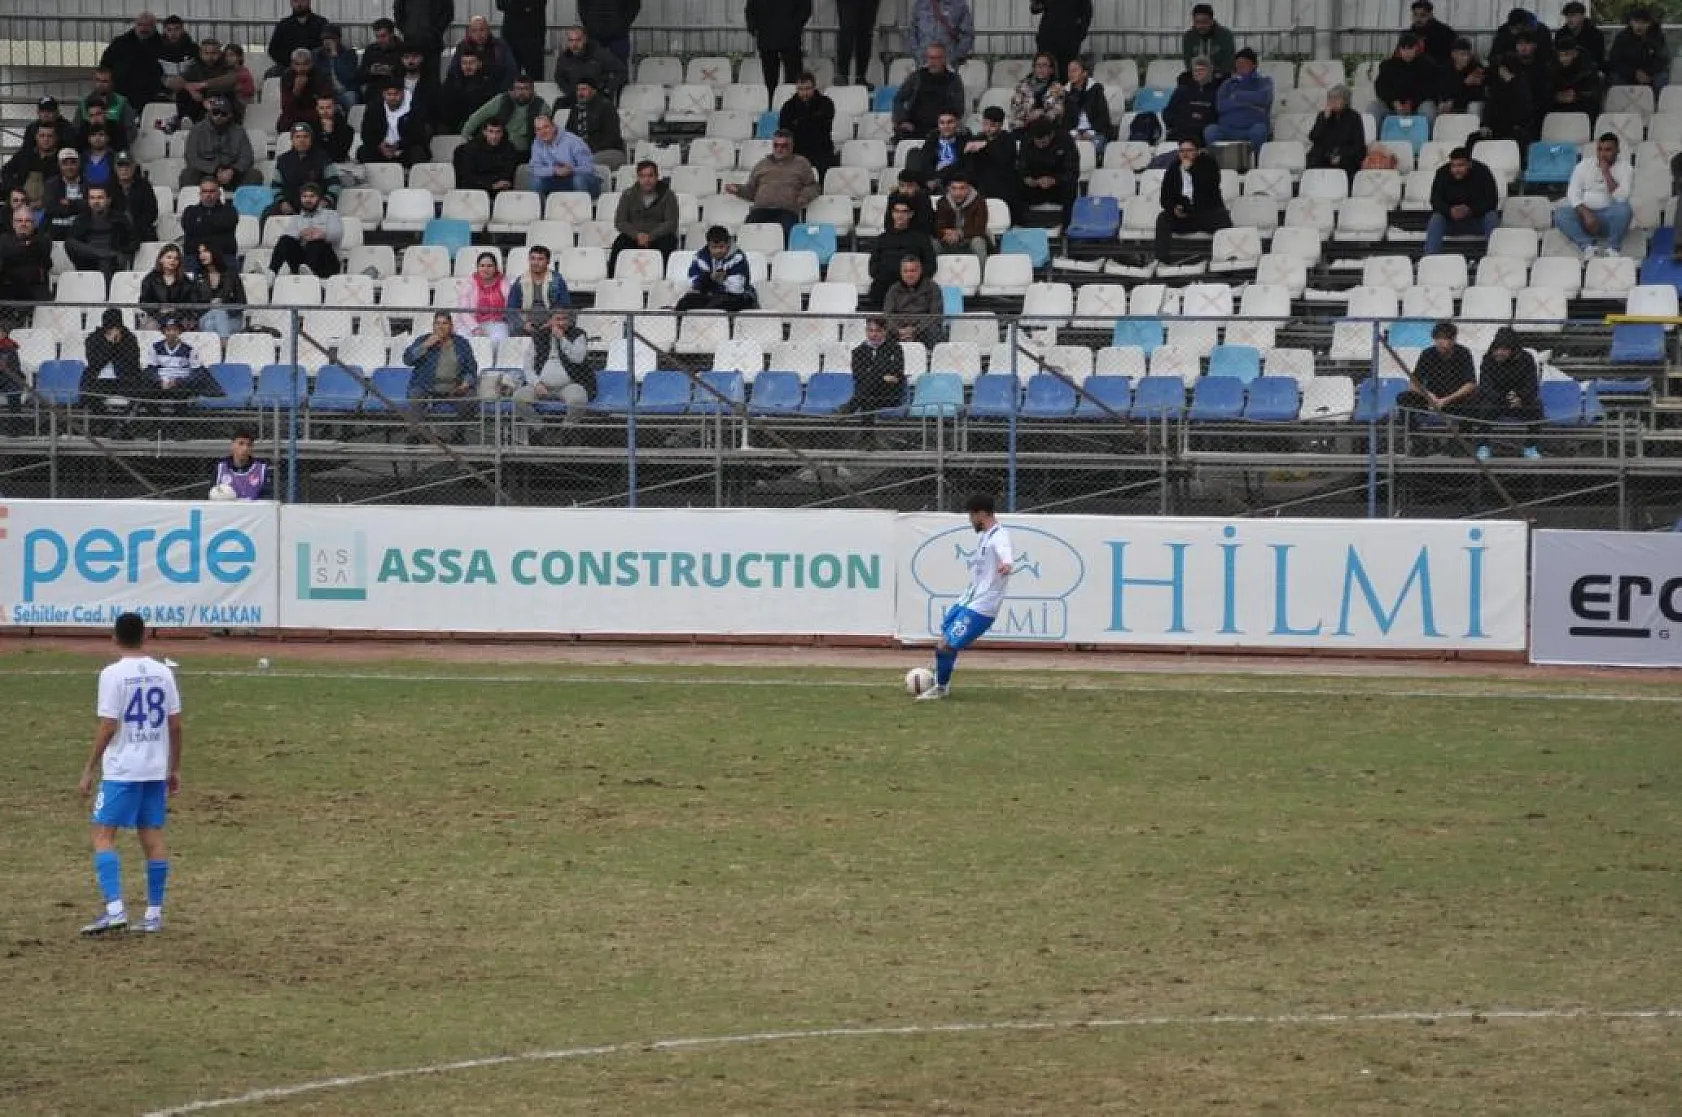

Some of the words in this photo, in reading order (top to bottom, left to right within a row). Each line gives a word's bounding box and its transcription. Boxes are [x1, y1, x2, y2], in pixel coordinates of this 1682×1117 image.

[24, 509, 256, 602] perde
[377, 548, 497, 584] ASSA
[511, 549, 881, 589] CONSTRUCTION
[1103, 525, 1494, 639] HİLMİ
[73, 604, 106, 622] Cad.
[199, 605, 262, 623] KALKAN
[124, 686, 165, 729] 48
